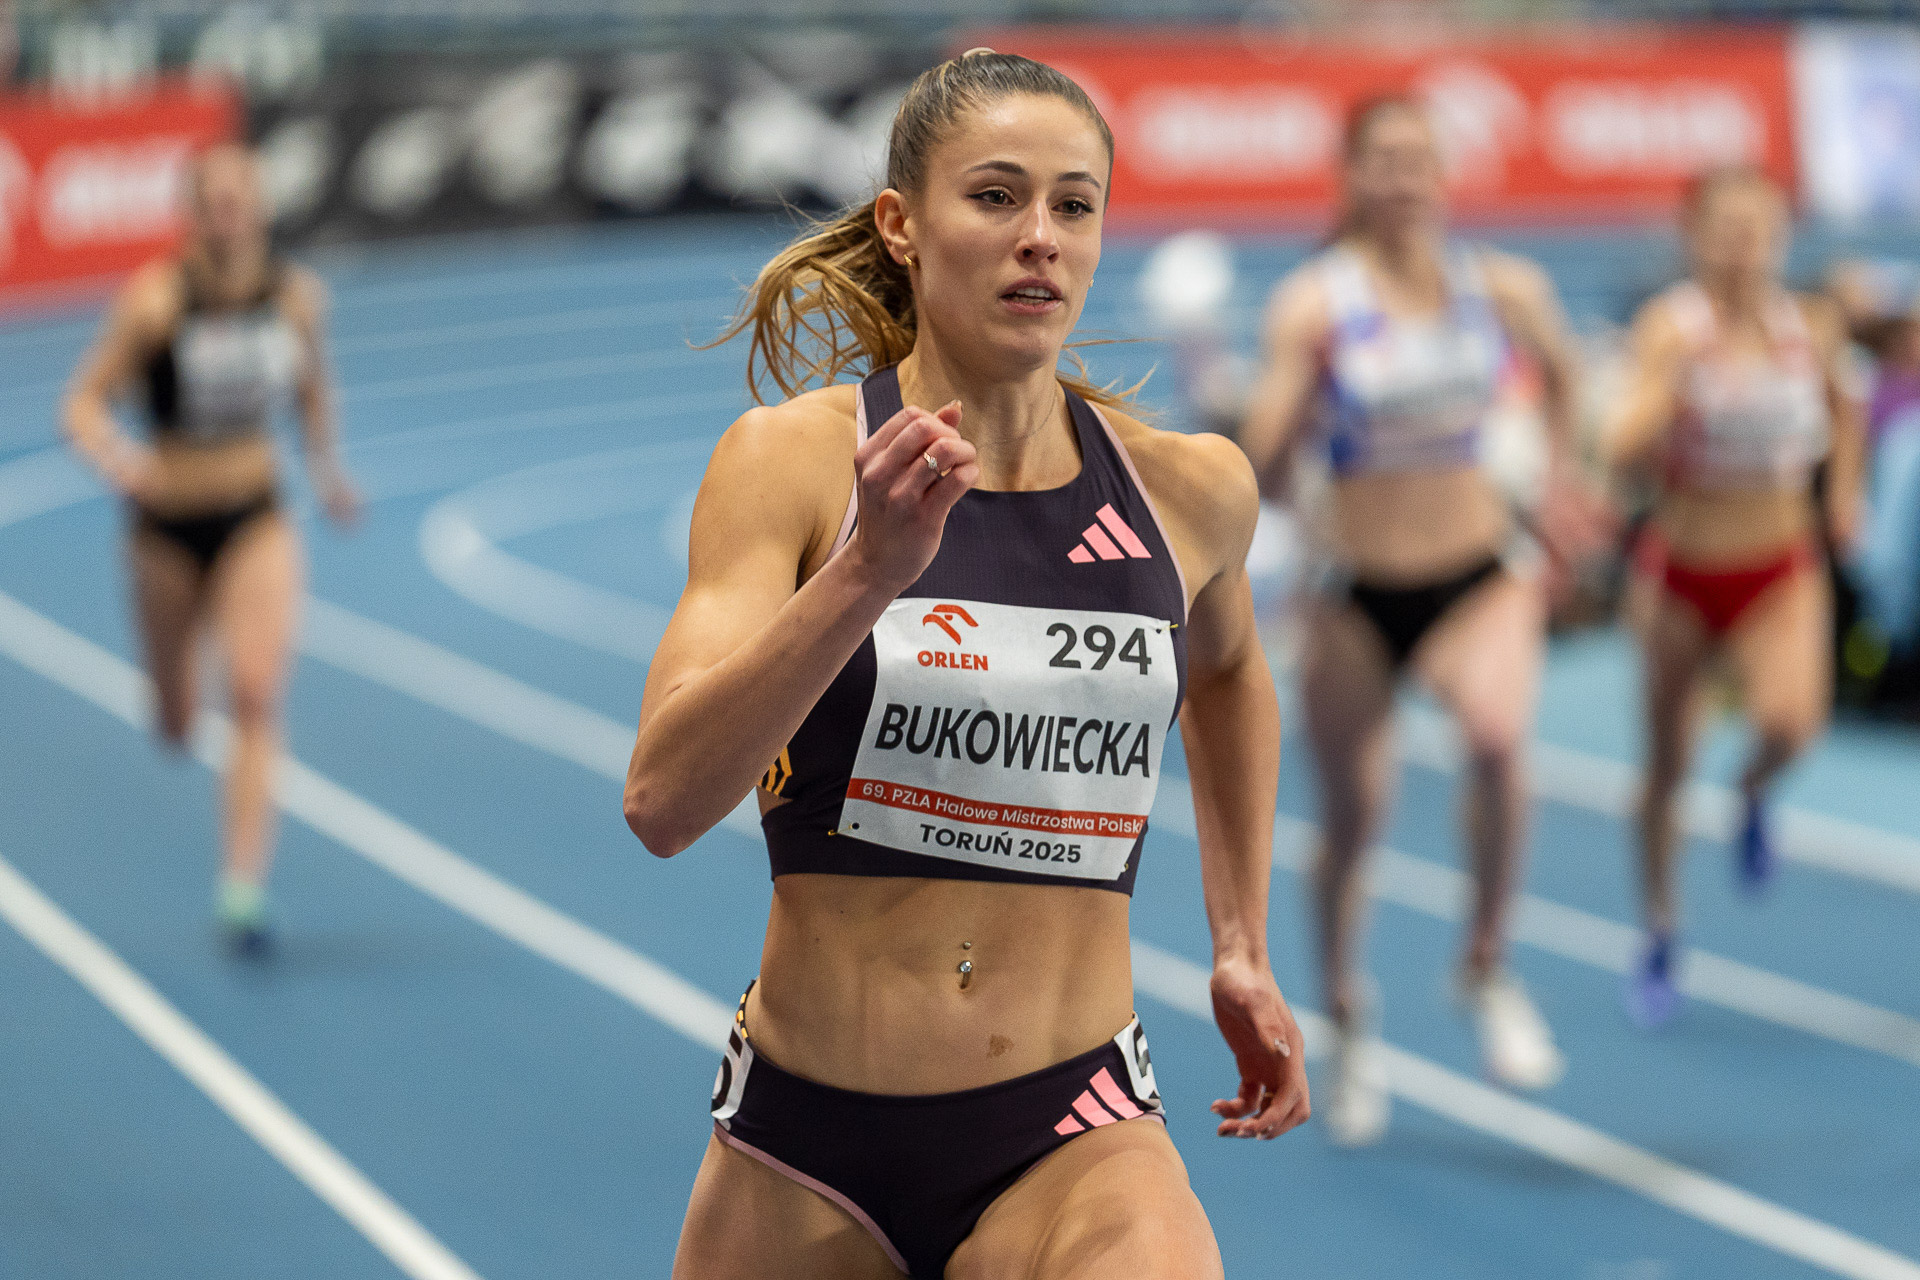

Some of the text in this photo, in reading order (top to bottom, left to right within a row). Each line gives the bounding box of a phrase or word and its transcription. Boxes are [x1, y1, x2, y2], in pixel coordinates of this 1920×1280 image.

[917, 650, 989, 672] ORLEN
[1046, 622, 1152, 675] 294
[874, 703, 1151, 778] BUKOWIECKA
[862, 782, 1143, 835] 69. PZLA Halowe Mistrzostwa Polski
[919, 823, 1082, 864] TORUŃ 2025
